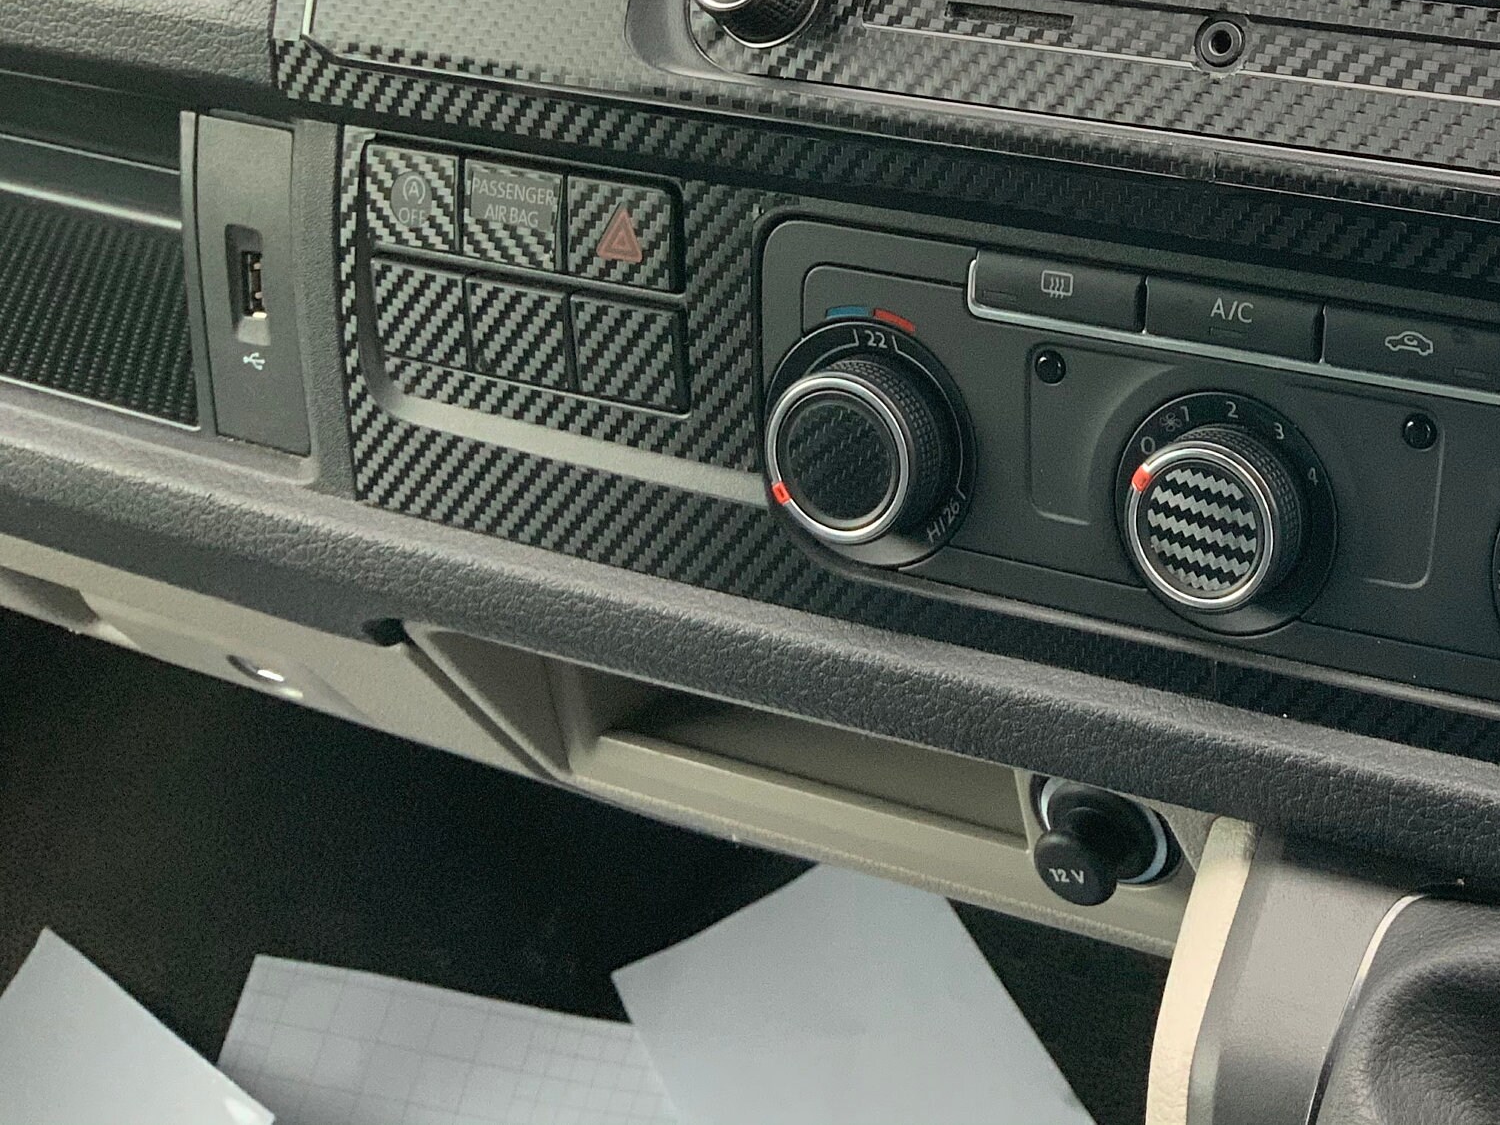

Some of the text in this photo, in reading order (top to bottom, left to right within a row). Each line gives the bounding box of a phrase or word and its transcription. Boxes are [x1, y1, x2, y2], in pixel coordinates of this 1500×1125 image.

[472, 177, 555, 206] PASSENGER
[399, 207, 427, 225] OFF
[484, 204, 539, 228] AIR BAG
[1210, 297, 1254, 324] A/C
[867, 330, 888, 349] 22
[1140, 400, 1318, 486] 0 1 2 3 4
[1049, 868, 1085, 885] 12 V
